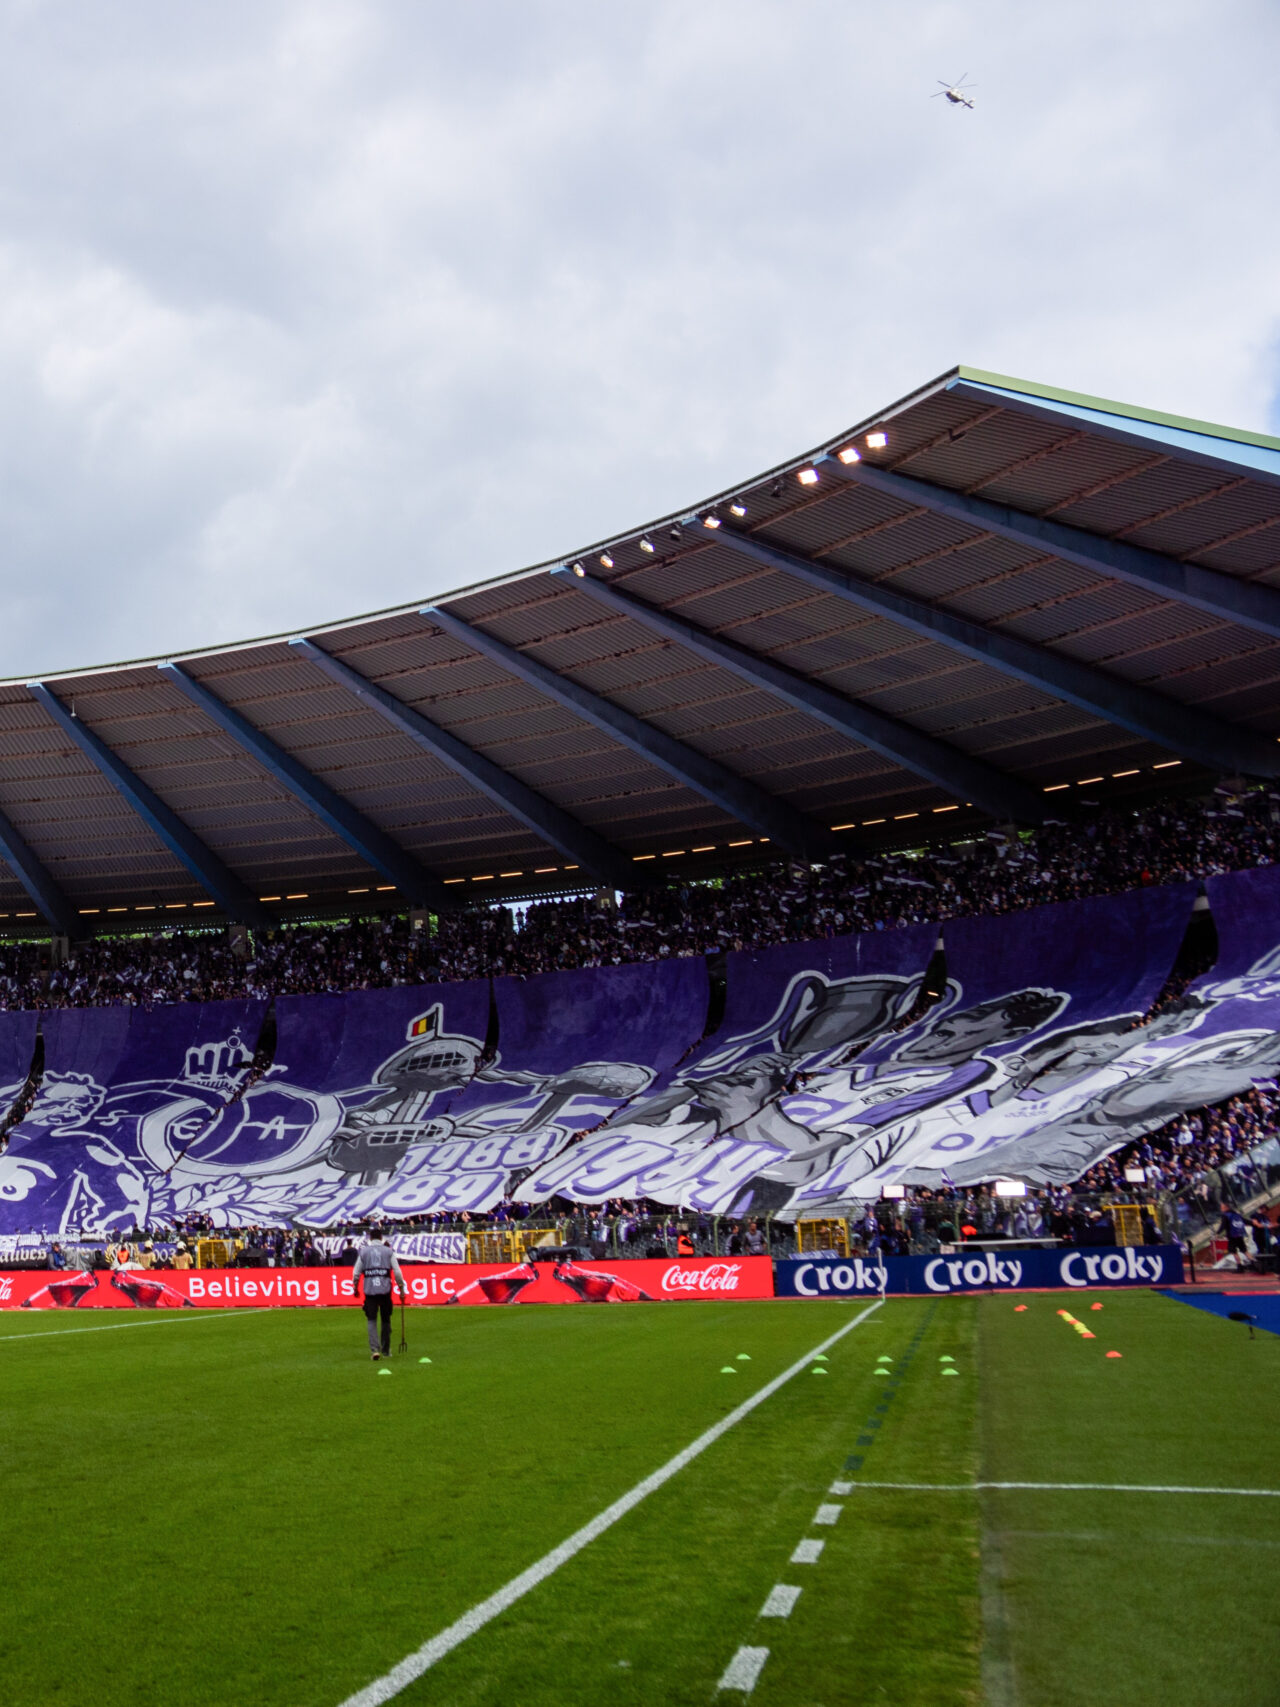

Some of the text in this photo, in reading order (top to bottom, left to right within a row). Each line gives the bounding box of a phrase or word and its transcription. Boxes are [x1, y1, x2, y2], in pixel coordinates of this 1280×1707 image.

[400, 1131, 557, 1175] 1988
[391, 1233, 464, 1261] LEADERS
[794, 1258, 887, 1295] Croky
[924, 1252, 1022, 1292] Croky
[1060, 1247, 1163, 1286] Croky
[189, 1276, 320, 1300] Believing
[332, 1275, 354, 1296] is
